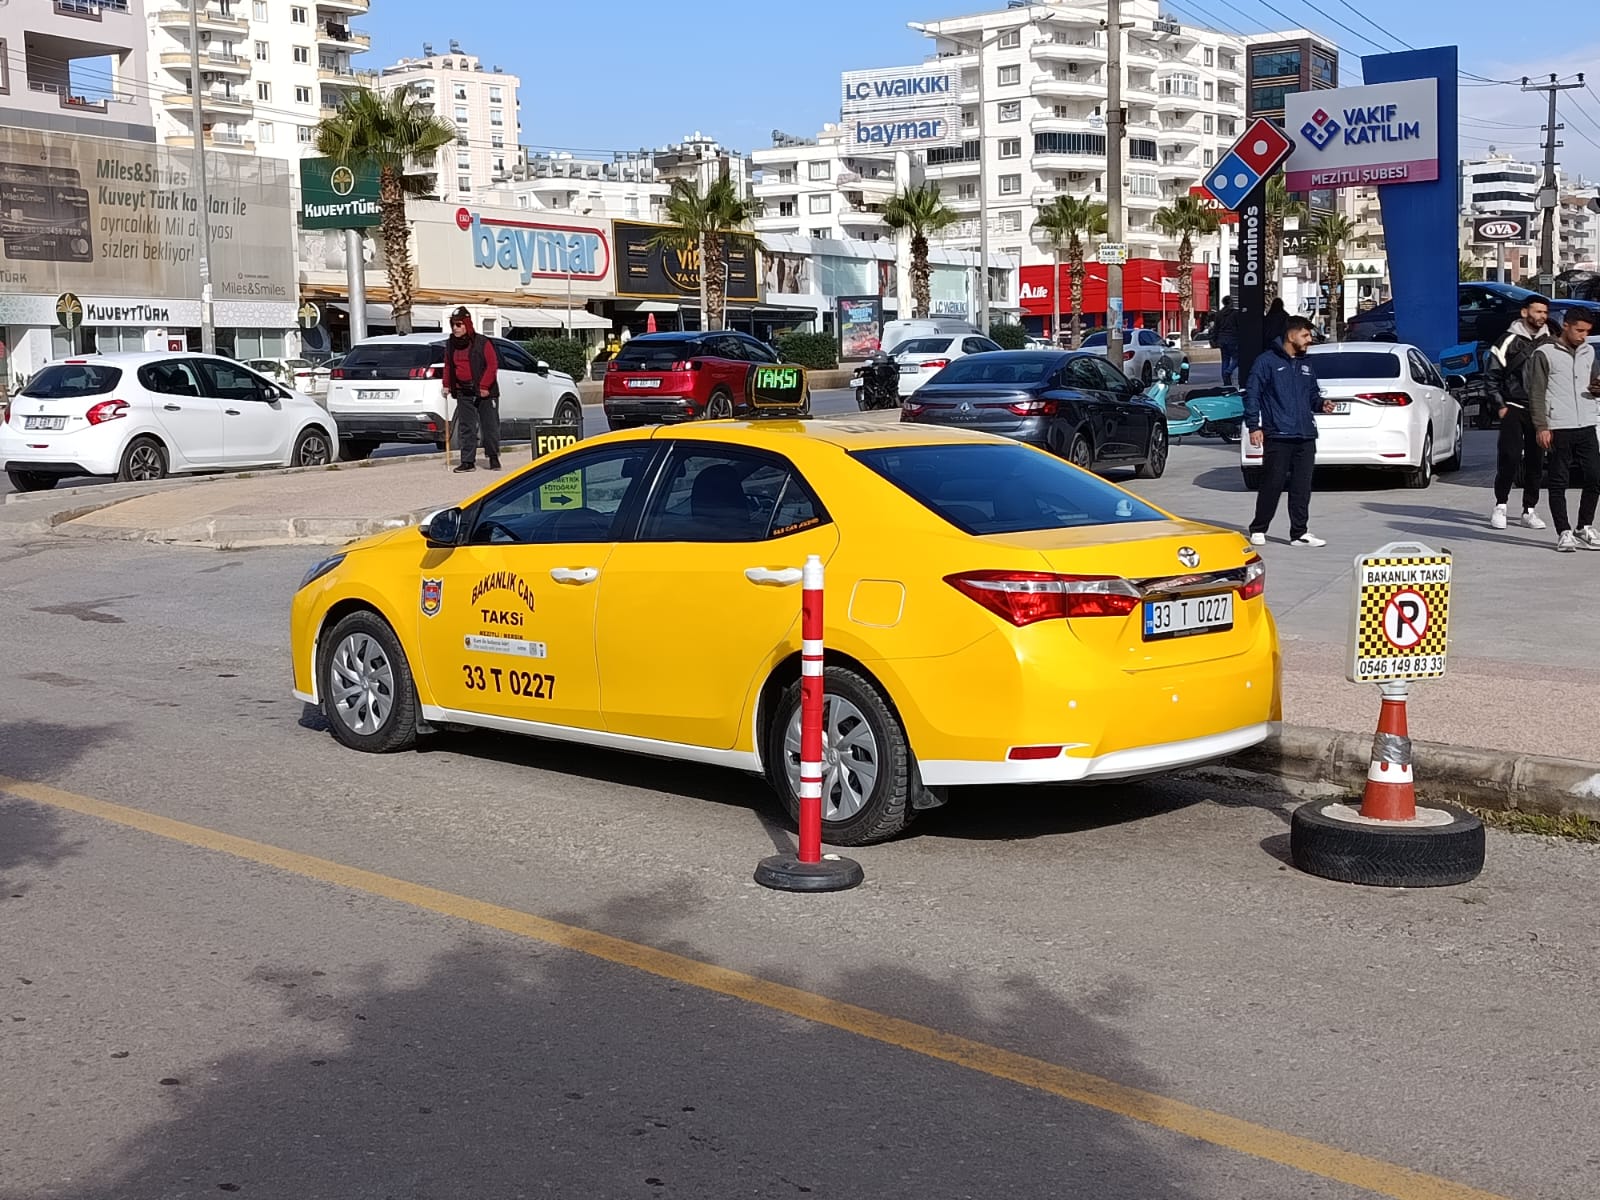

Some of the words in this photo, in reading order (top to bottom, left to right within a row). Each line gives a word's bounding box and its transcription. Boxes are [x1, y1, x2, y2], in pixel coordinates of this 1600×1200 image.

[846, 83, 870, 100] LC
[1343, 104, 1397, 125] VAKIF
[856, 119, 942, 146] baymar
[1344, 121, 1420, 145] KATILIM
[96, 158, 187, 187] Miles&Smiles
[1311, 171, 1360, 186] MEZİTLİ
[1363, 166, 1409, 183] ŞUBESİ
[98, 185, 146, 212] Kuveyt
[149, 190, 178, 211] Türk
[232, 197, 247, 216] ile
[100, 214, 161, 237] ayrıcalıklı
[165, 217, 184, 237] Mil
[1485, 224, 1513, 235] OVA
[102, 241, 139, 260] sizleri
[143, 243, 195, 267] bekliyor!
[472, 213, 599, 285] baymar
[1243, 205, 1259, 286] Domino's
[221, 282, 286, 296] Miles&Smiles
[87, 304, 170, 322] KUVEYTTÜRK
[472, 571, 517, 606] BAKANLIK
[1367, 571, 1417, 583] BAKANLIK
[1154, 604, 1171, 629] 33
[1181, 602, 1188, 625] T
[1198, 597, 1228, 623] 0227
[1360, 660, 1388, 674] 0546
[1391, 658, 1411, 672] 149
[1414, 657, 1427, 672] 83
[1430, 656, 1443, 670] 33
[463, 664, 487, 690] 33
[490, 668, 502, 693] T
[509, 670, 556, 700] 0227
